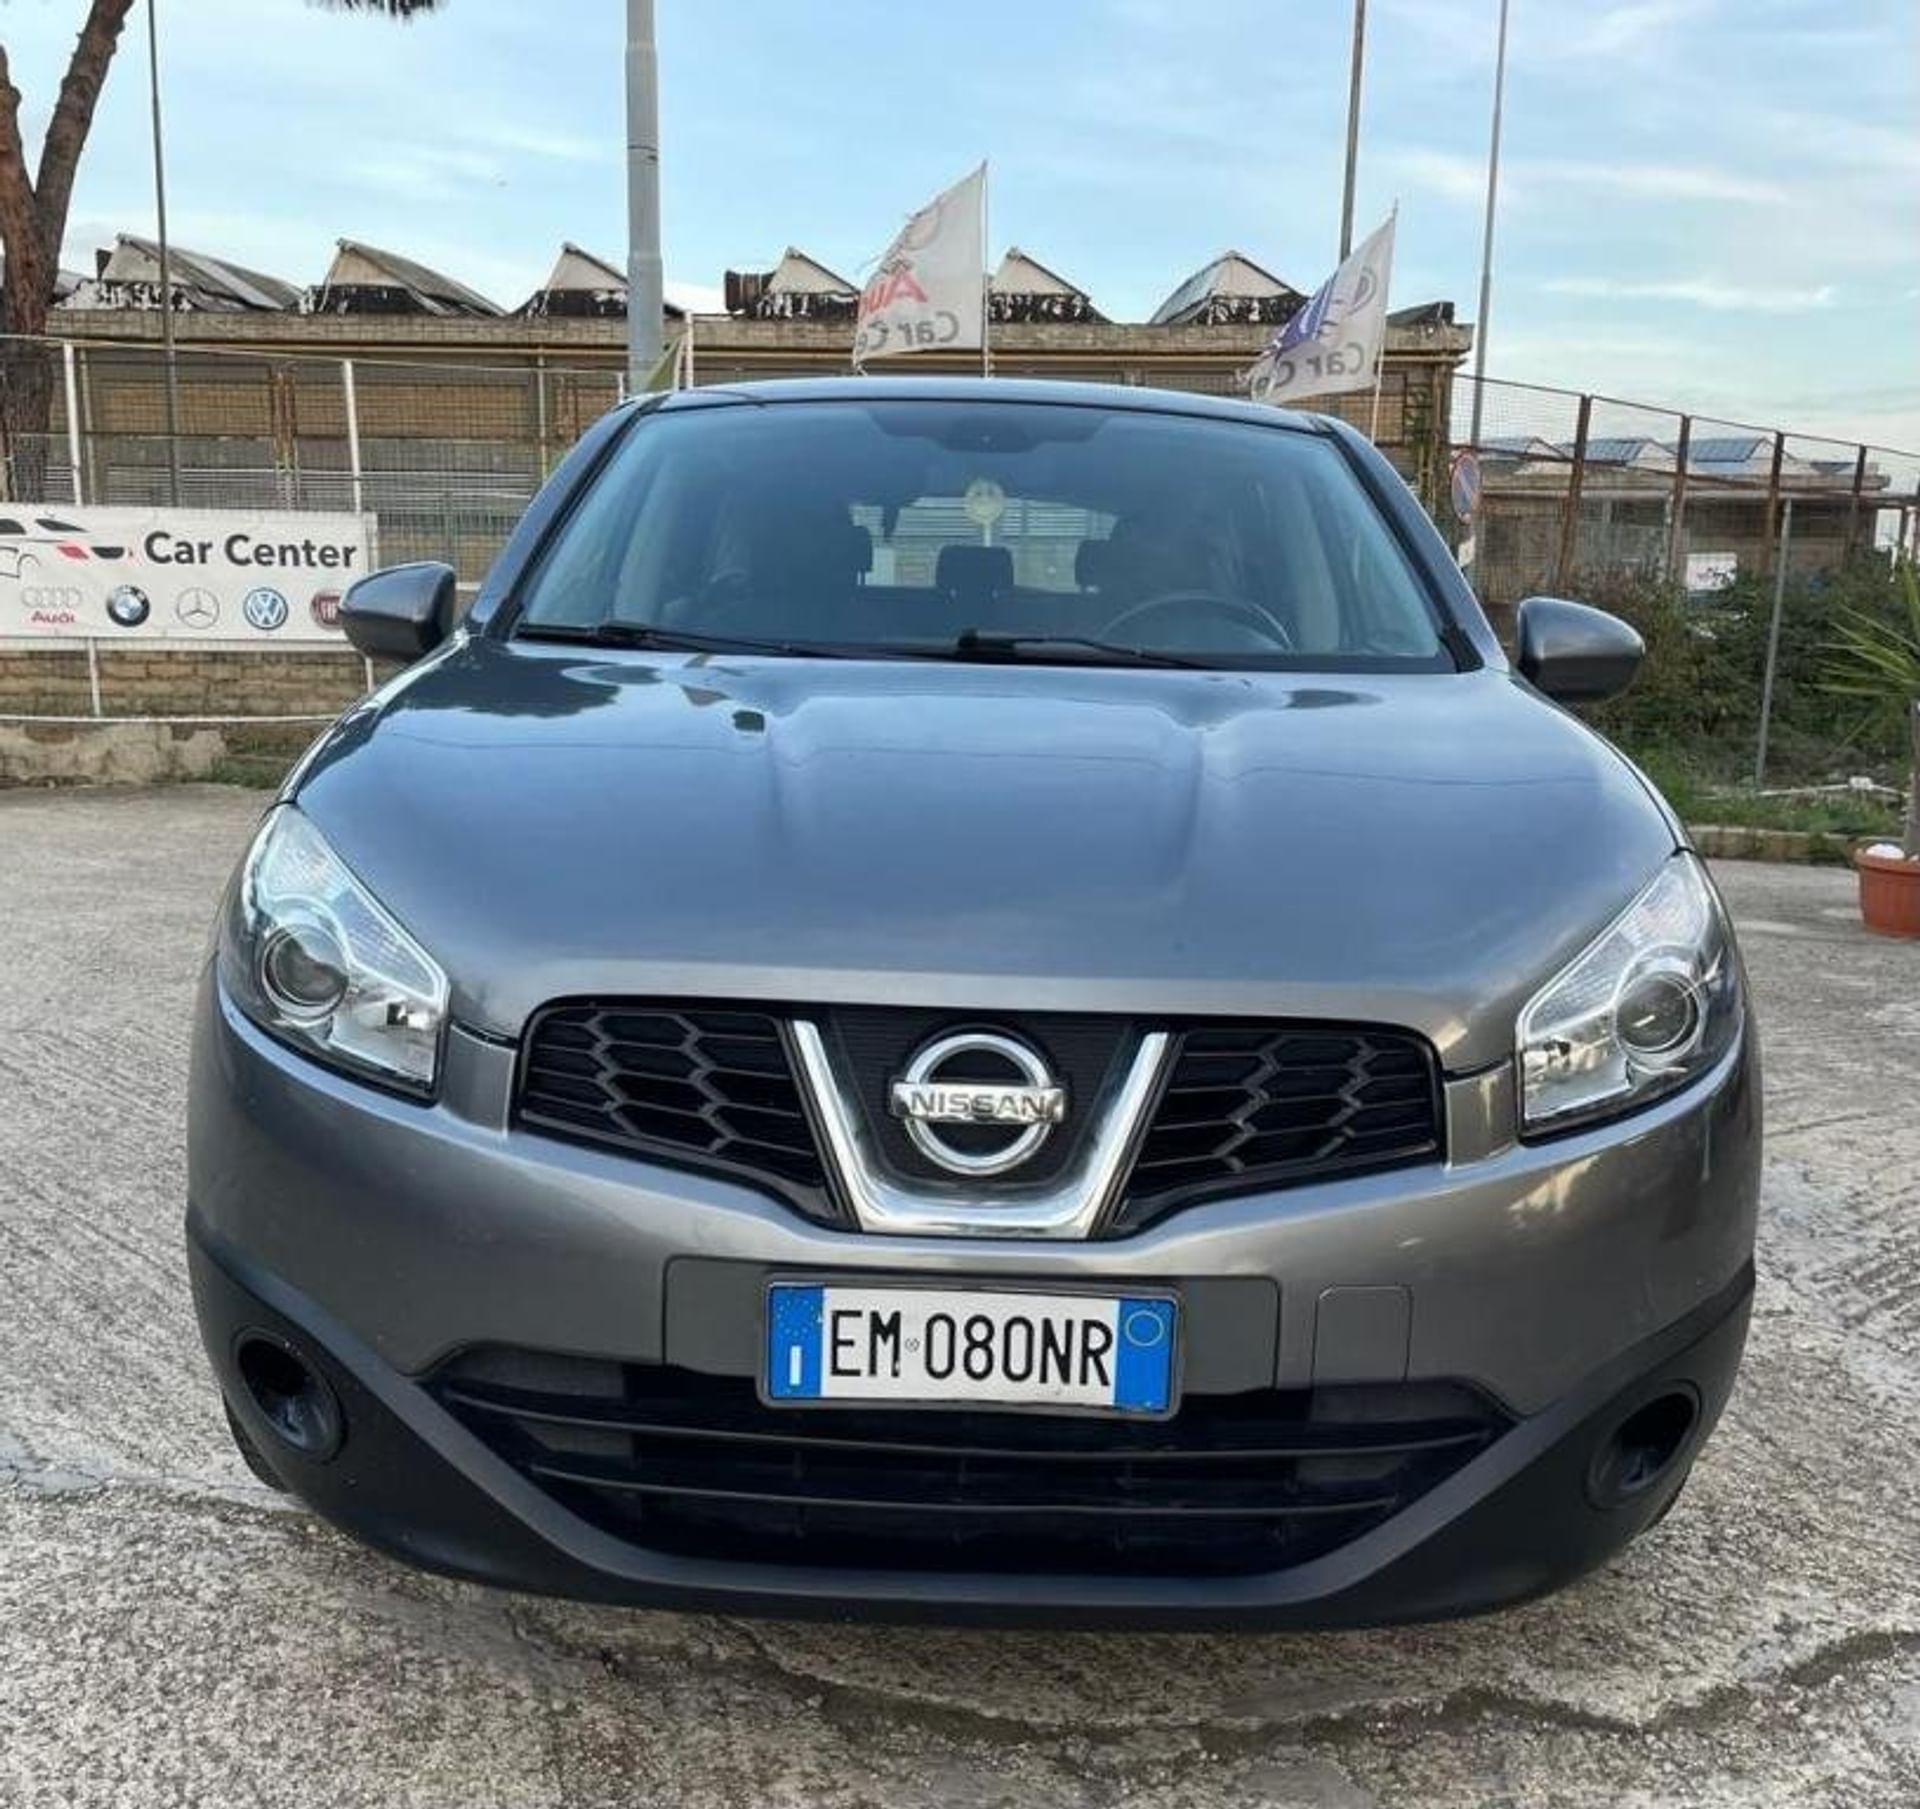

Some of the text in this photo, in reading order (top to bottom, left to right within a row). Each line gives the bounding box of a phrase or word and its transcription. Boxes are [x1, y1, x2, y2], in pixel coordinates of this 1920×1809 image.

[144, 531, 357, 568] Car Center
[31, 610, 75, 624] Audi
[911, 1091, 1047, 1117] NISSAN
[830, 1310, 1114, 1387] EM 080NR
